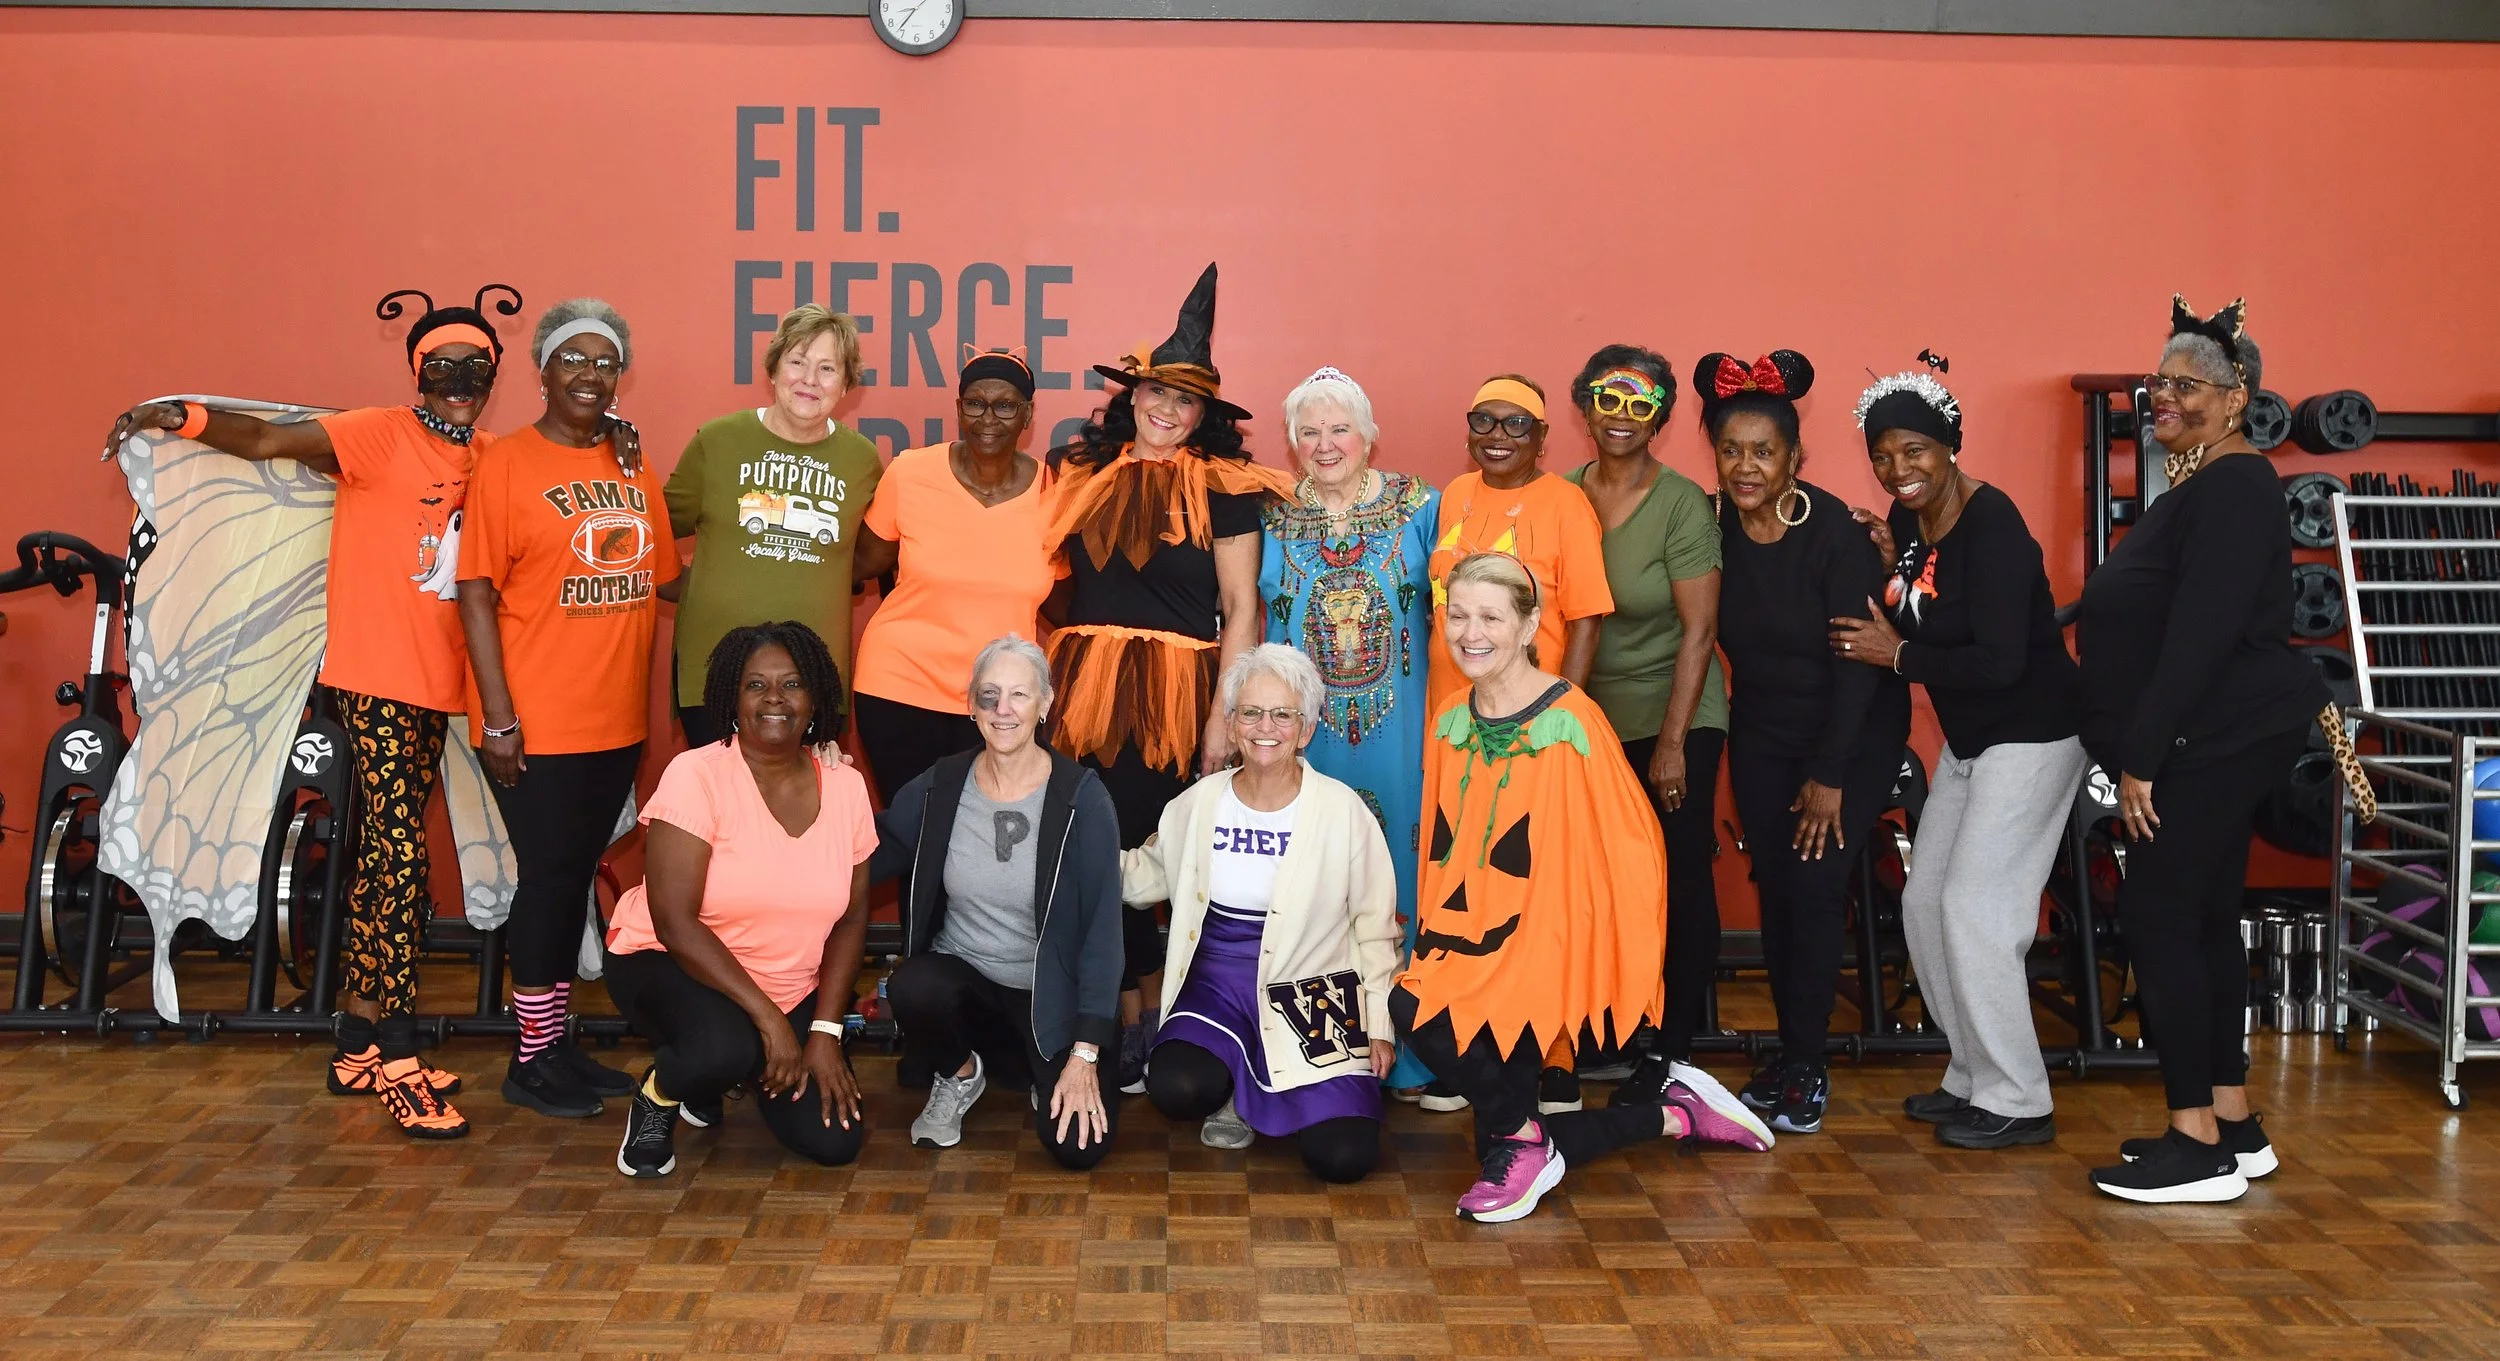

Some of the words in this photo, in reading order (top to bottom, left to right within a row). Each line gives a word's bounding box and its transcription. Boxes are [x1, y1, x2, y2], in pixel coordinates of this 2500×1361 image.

[883, 3, 889, 12] 9
[945, 4, 951, 13] 3
[888, 18, 894, 27] 8
[940, 19, 946, 28] 4
[900, 29, 905, 38] 7
[914, 33, 920, 42] 6
[929, 30, 935, 39] 5
[736, 106, 899, 232] FIT.
[763, 450, 796, 464] Farm
[798, 455, 830, 471] Fresh
[739, 461, 846, 501] PUMPKINS
[787, 538, 810, 548] DAILY
[745, 543, 786, 561] Locally
[788, 548, 821, 564] Grown
[566, 607, 604, 616] CHOICES
[606, 605, 628, 615] STILL
[993, 810, 1031, 863] P
[1266, 969, 1370, 1068] W
